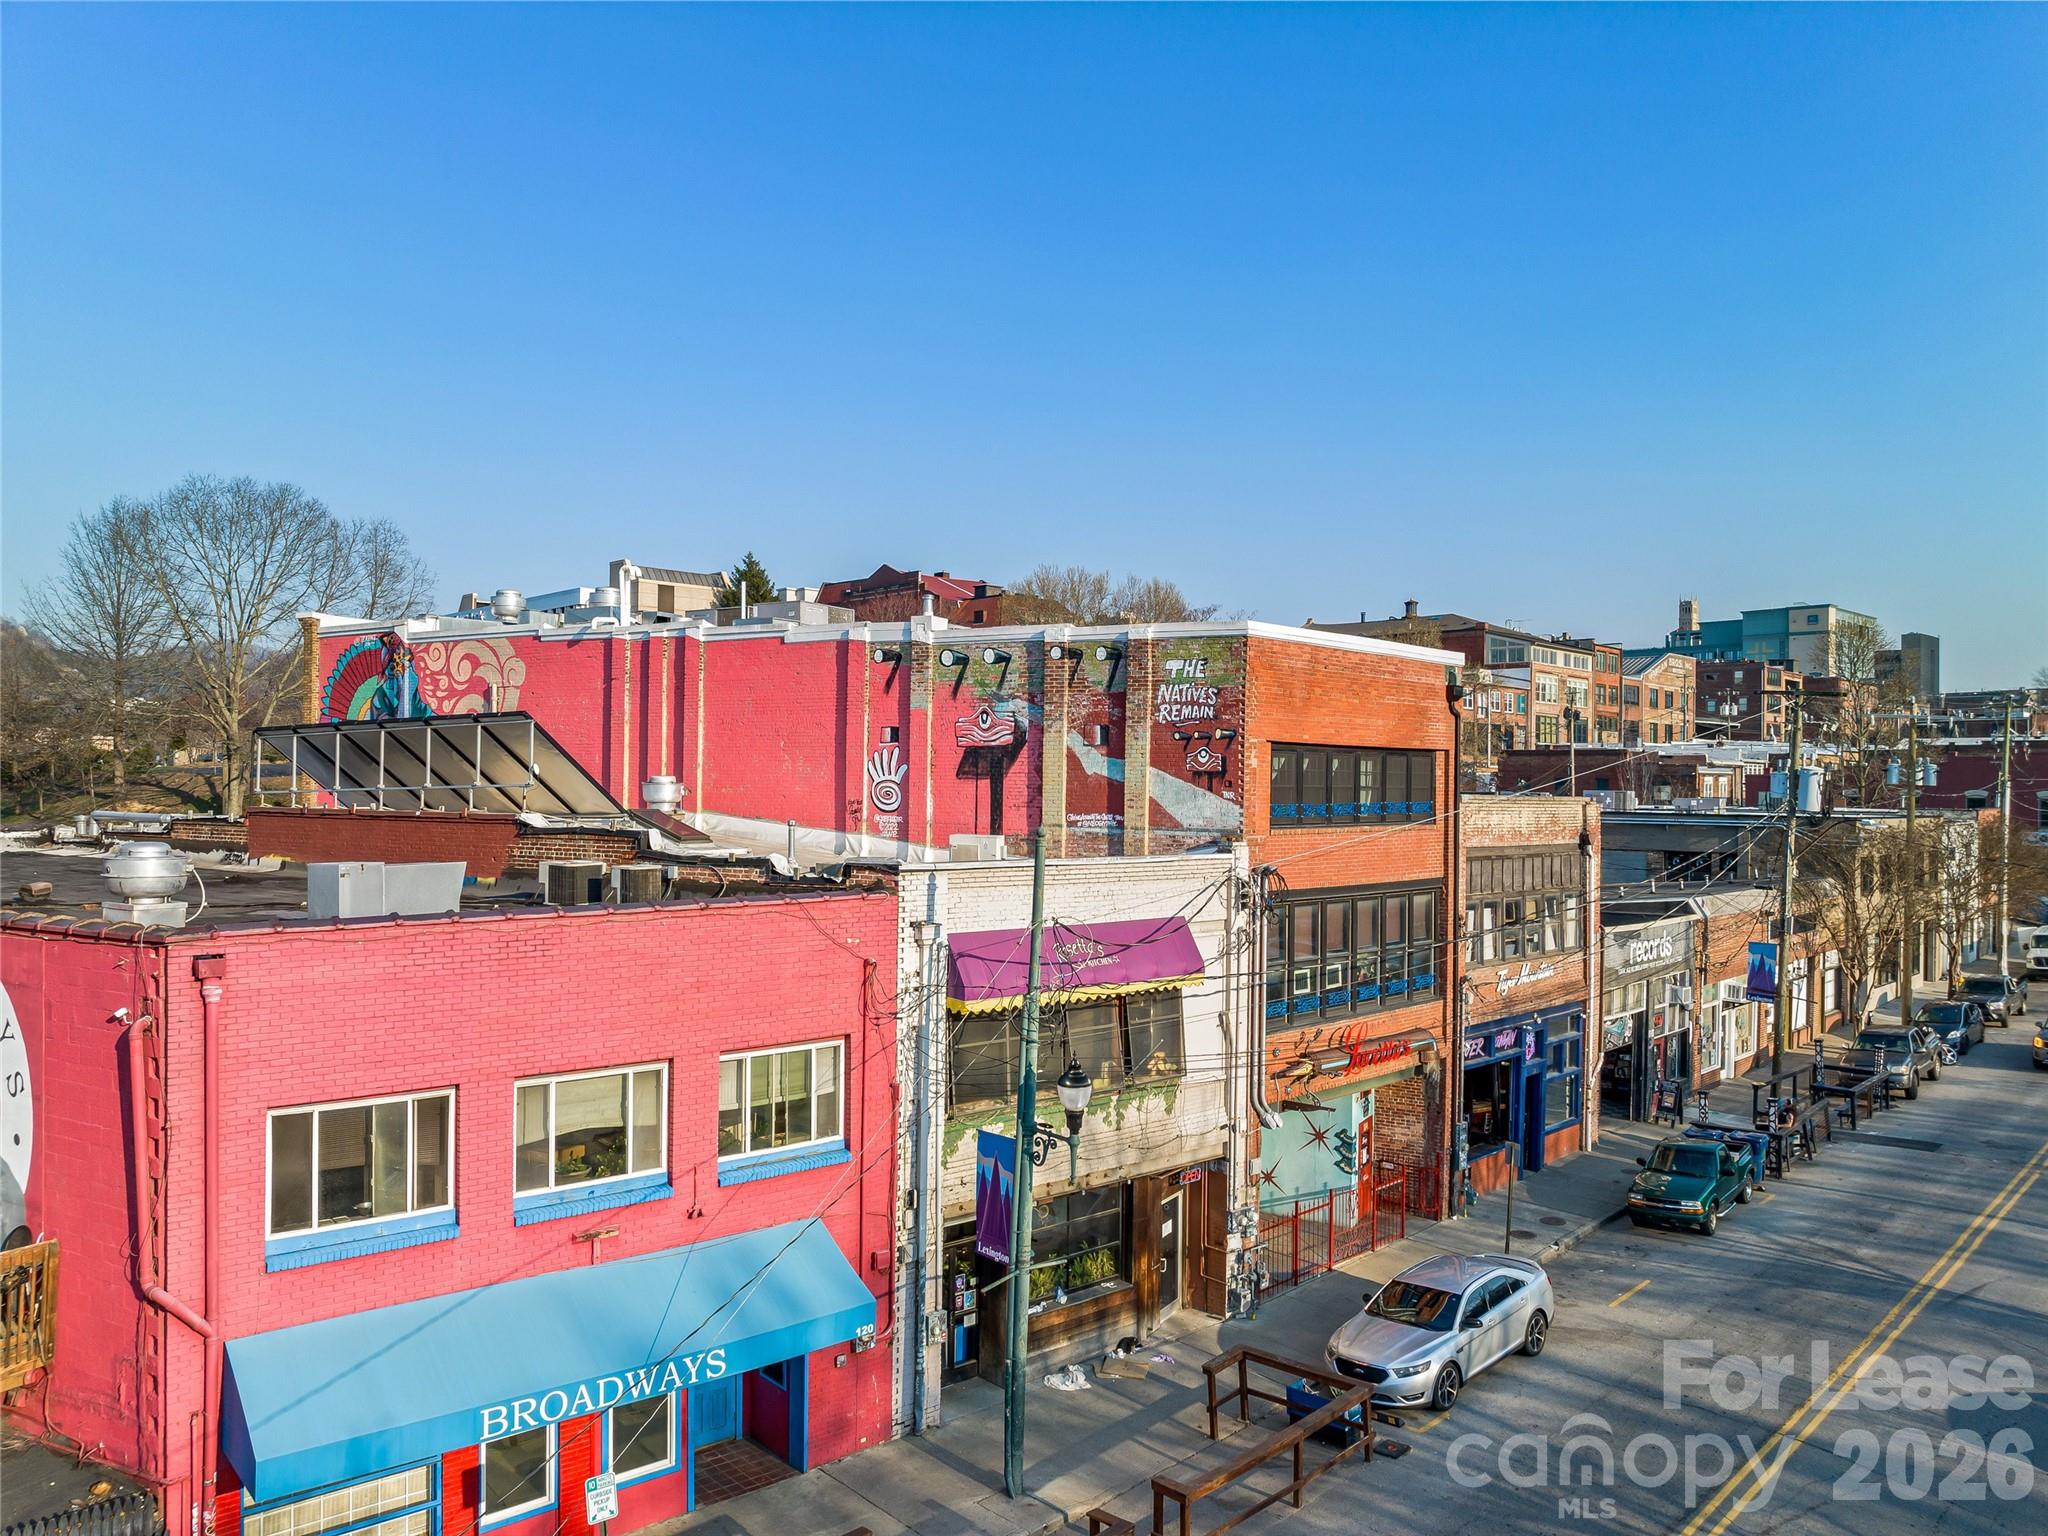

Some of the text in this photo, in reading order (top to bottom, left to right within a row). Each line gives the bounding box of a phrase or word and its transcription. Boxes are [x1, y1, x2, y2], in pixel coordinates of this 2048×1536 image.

[1165, 659, 1207, 678] THE
[1158, 703, 1214, 722] REMAIN
[1630, 929, 1673, 965] records
[1496, 968, 1519, 996] Tiger
[1182, 1170, 1200, 1182] OPEN
[977, 1241, 1010, 1263] Lexington
[856, 1323, 874, 1337] 120
[479, 1348, 727, 1441] BROADWAYS
[593, 1497, 610, 1506] PICKUP
